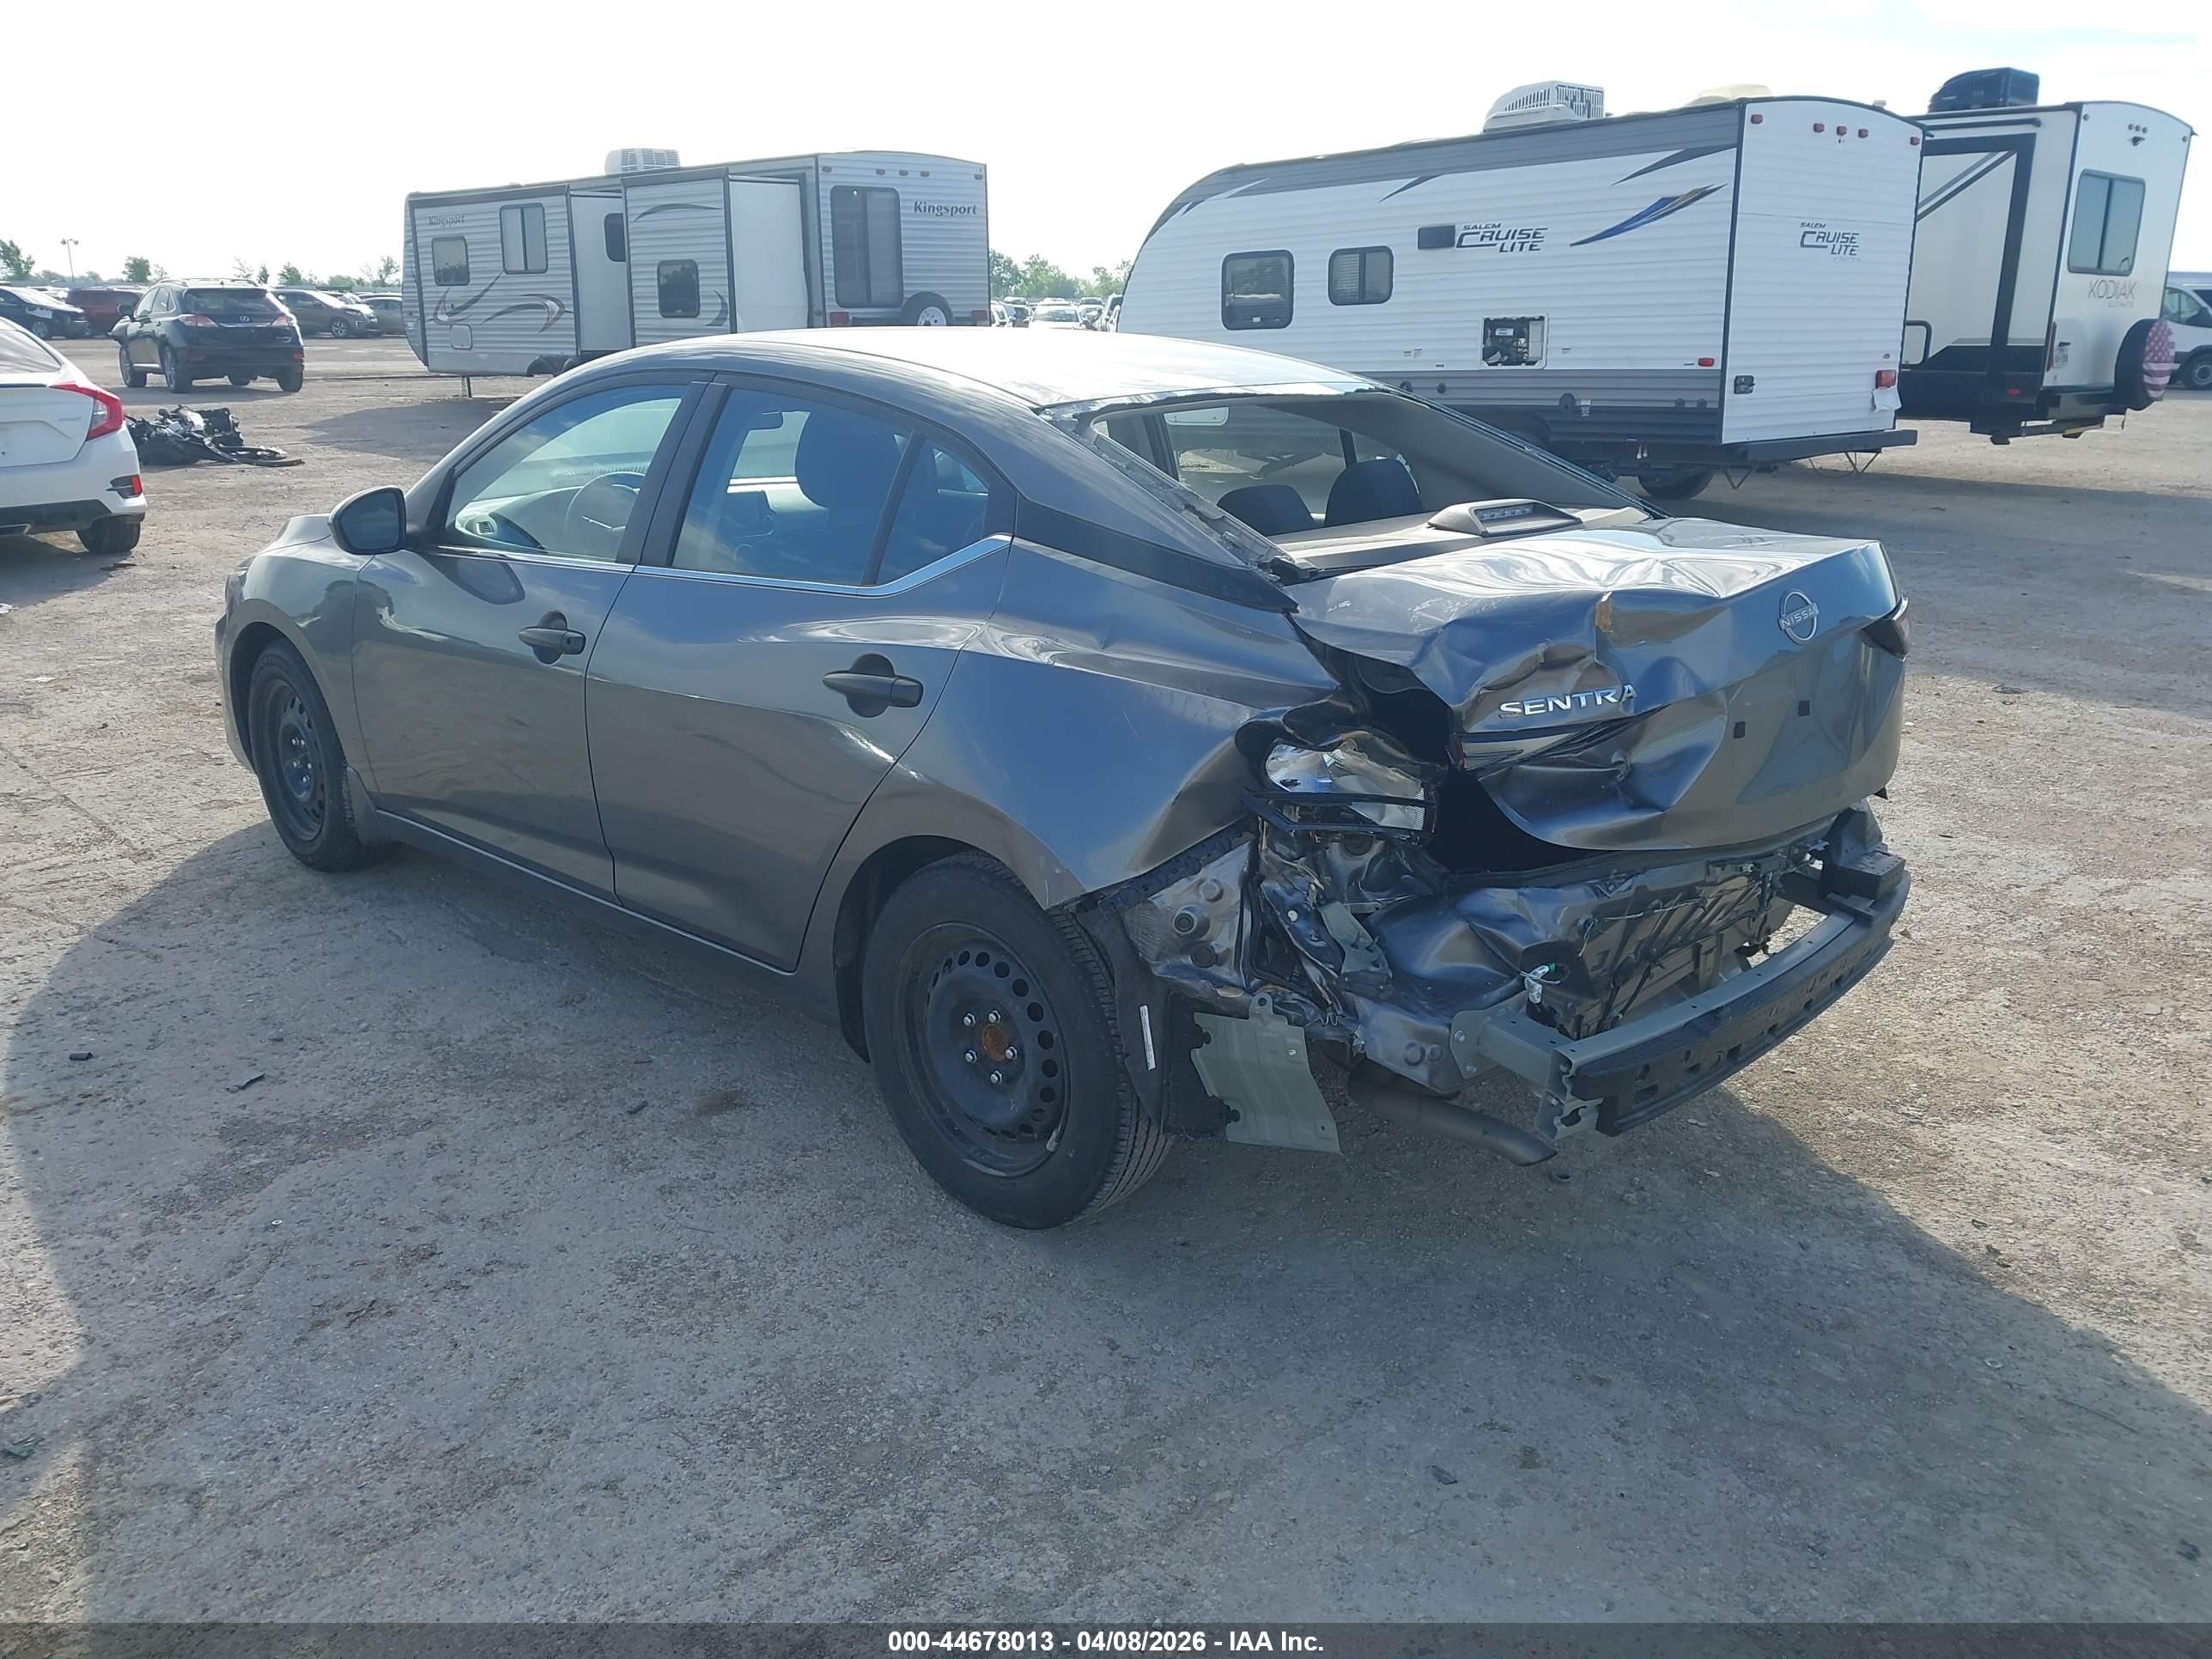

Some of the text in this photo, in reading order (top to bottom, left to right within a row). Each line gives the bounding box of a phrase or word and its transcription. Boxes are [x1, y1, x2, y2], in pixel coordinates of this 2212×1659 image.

[914, 201, 976, 217] Kingsport
[428, 214, 465, 227] Kingsport
[1456, 228, 1548, 248] CRUISE
[1499, 240, 1545, 252] LITE
[1801, 231, 1860, 248] CRUISE
[1831, 244, 1859, 256] LITE
[2088, 279, 2137, 300] KODIAK
[1498, 684, 1638, 719] SENTRA
